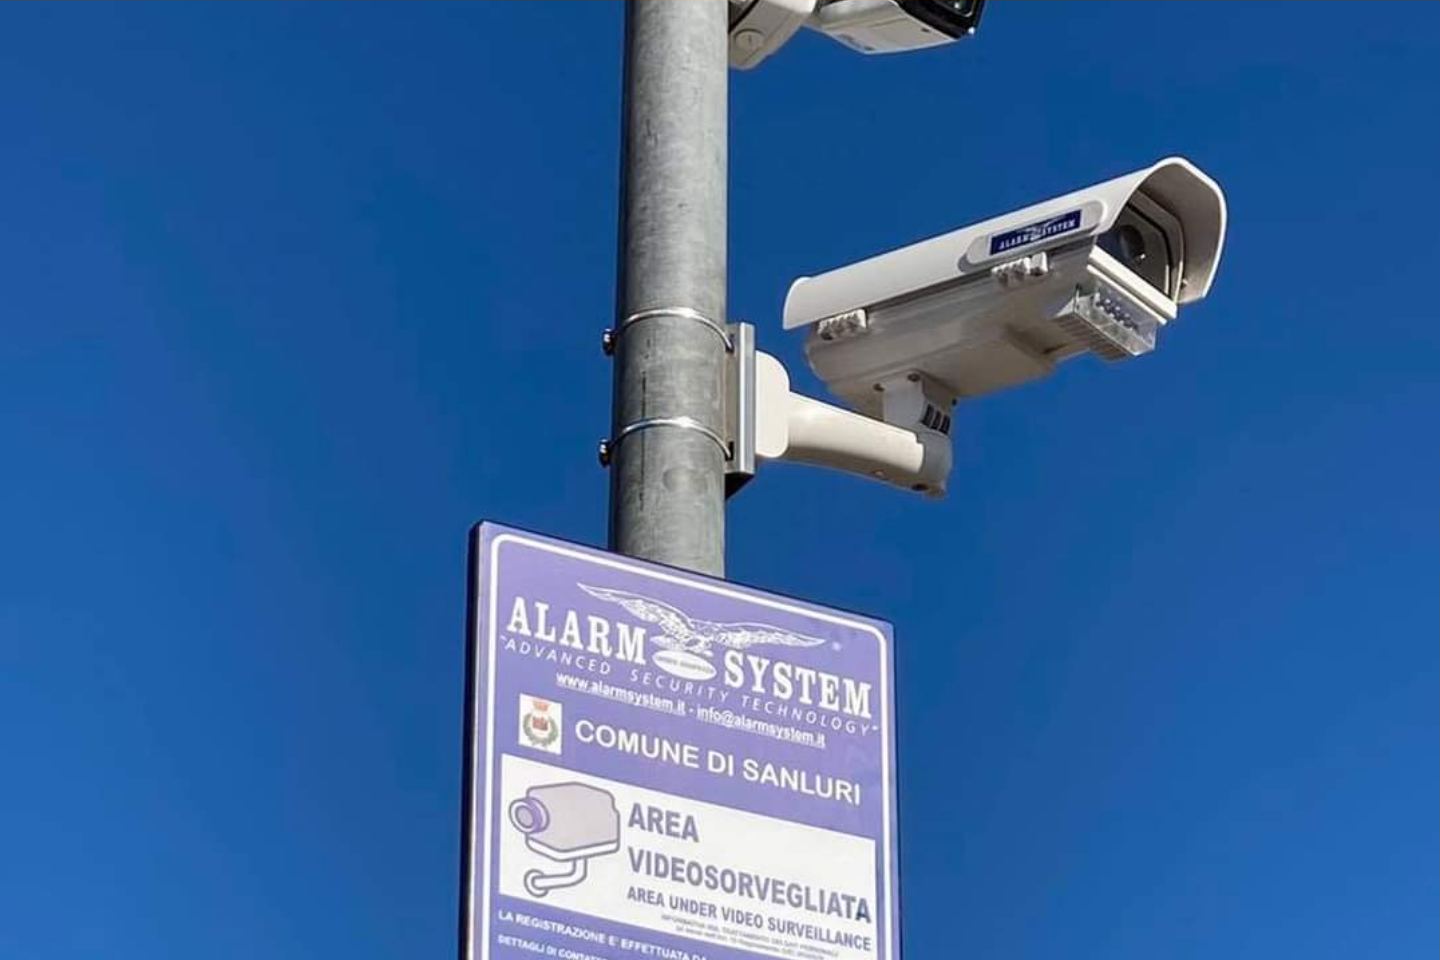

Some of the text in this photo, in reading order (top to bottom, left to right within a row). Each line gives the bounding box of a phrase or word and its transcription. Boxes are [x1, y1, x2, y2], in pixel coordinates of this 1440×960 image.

[506, 596, 872, 719] ALARM SYSTEM
[630, 669, 729, 703] SECURITY
[556, 671, 686, 716] www.alarmsystem.it
[696, 703, 826, 749] info@alarmsystem.it
[575, 720, 861, 806] COMUNE DI SANLURI
[628, 802, 700, 843] AREA
[628, 845, 872, 924] VIDEOSORVEGLIATA
[498, 909, 513, 922] LA
[515, 913, 606, 944] REGISTRAZIONE
[620, 938, 690, 960] EFFETTUATA
[498, 934, 545, 953] DETTAGLI
[546, 944, 557, 956] DI
[627, 886, 665, 908] AREA
[668, 896, 717, 919] UNDER
[721, 906, 764, 929] VIDEO
[767, 916, 871, 951] SURVEILLANCE
